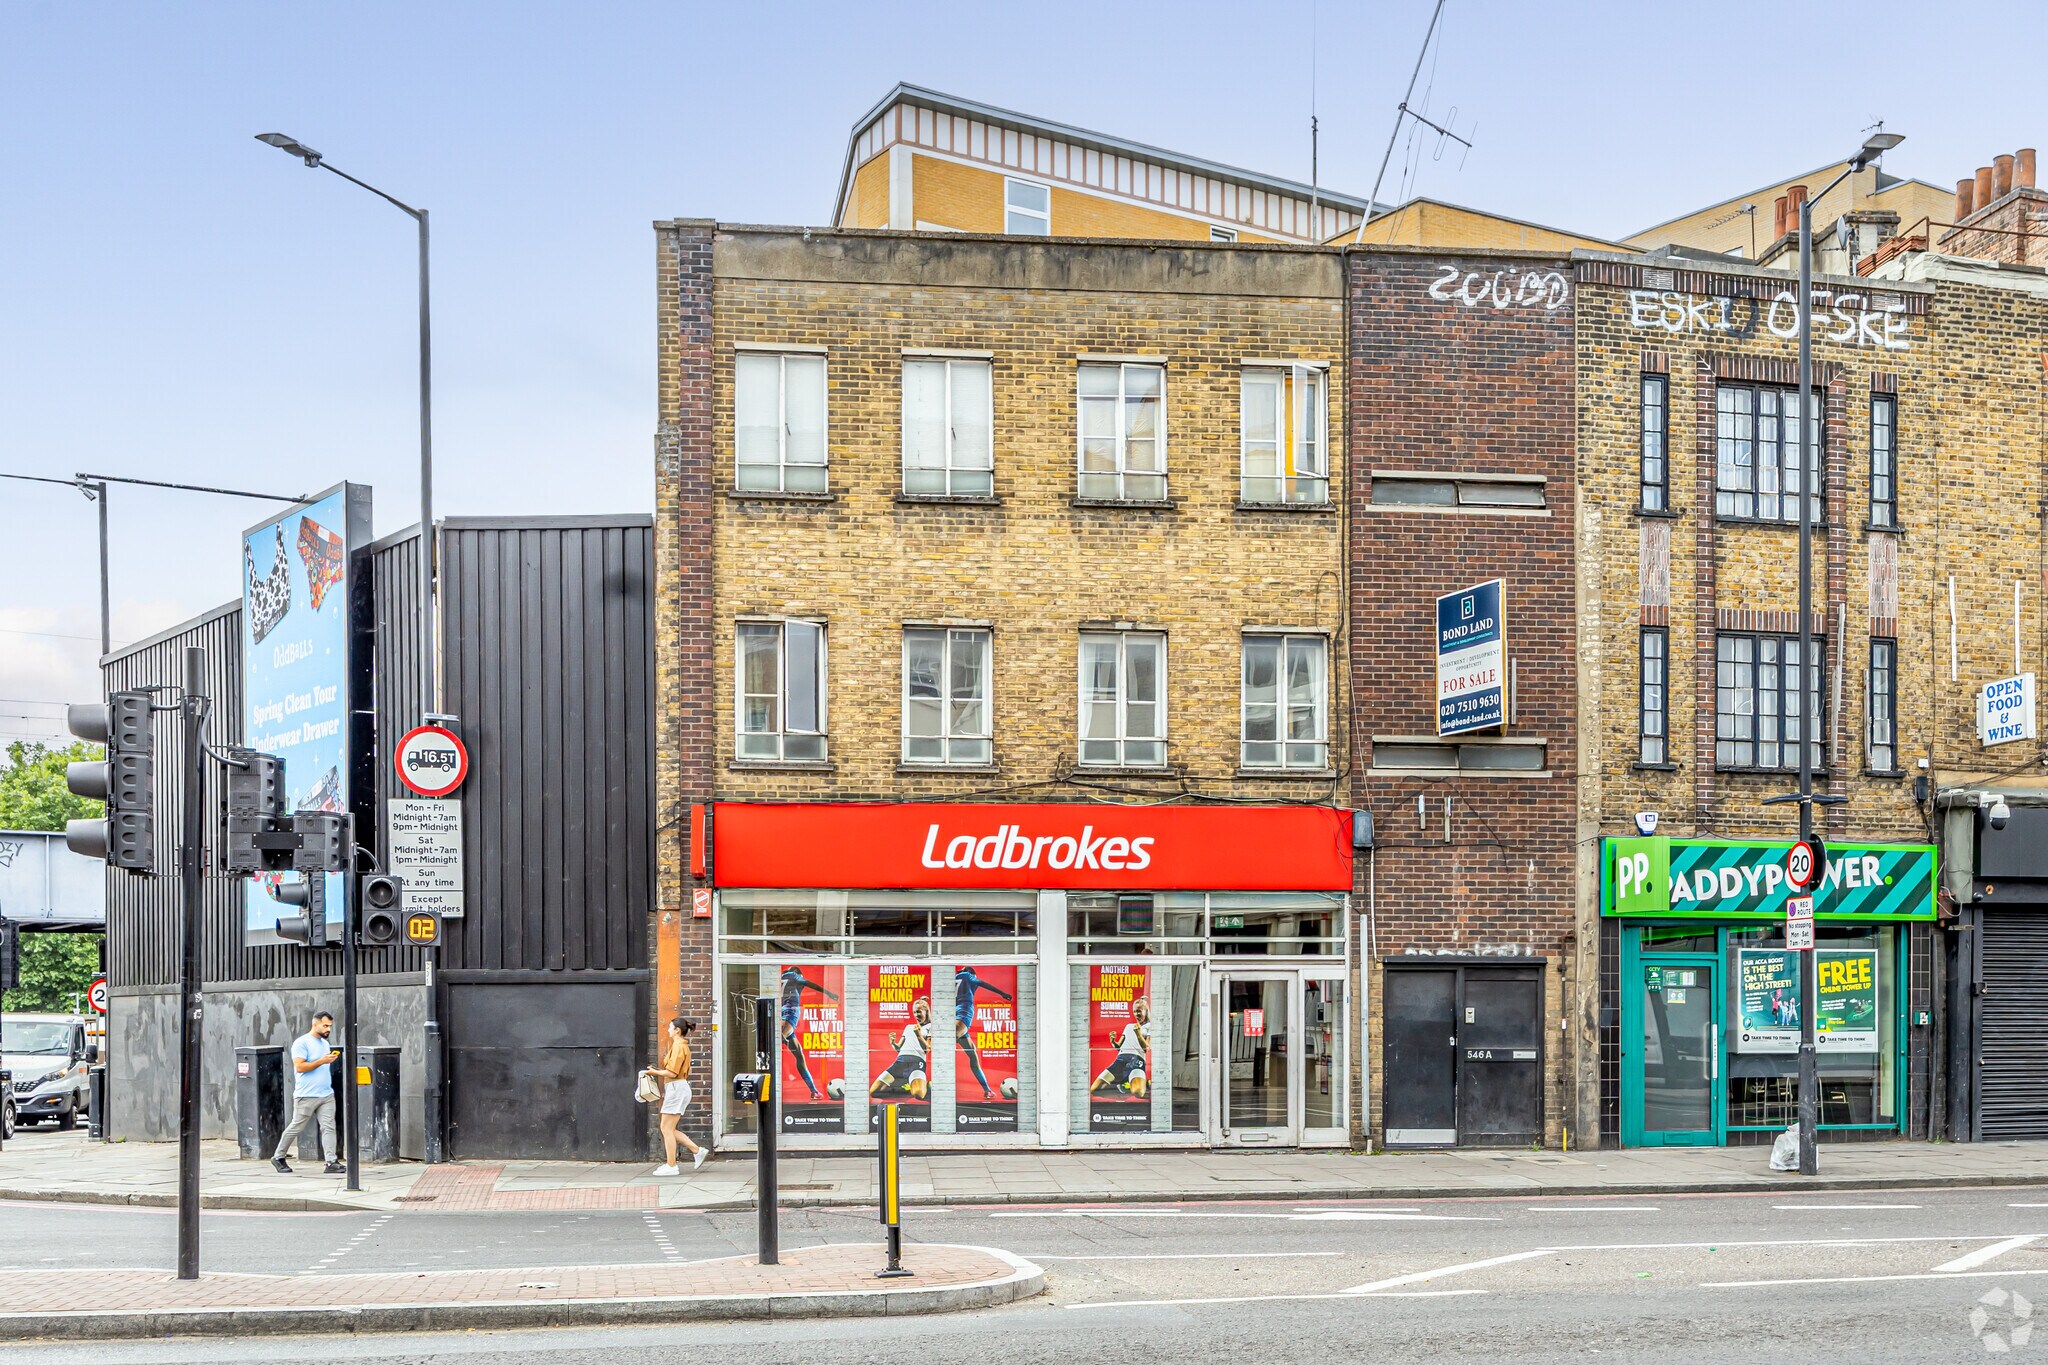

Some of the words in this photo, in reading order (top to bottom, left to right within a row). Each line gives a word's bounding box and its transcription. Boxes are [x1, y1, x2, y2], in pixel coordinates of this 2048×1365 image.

[1443, 625, 1468, 641] BOND
[1470, 617, 1493, 634] LAND
[1469, 649, 1500, 662] DEVELOPMENT
[1443, 676, 1466, 693] FOR
[1469, 668, 1496, 688] SALE
[1986, 679, 2023, 699] OPEN
[253, 699, 284, 728] Spring
[284, 692, 312, 715] Clean
[313, 685, 337, 707] Your
[1441, 703, 1455, 717] 020
[1457, 696, 1478, 713] 7510
[1479, 693, 1500, 709] 9630
[1987, 695, 2022, 713] FOOD
[1440, 709, 1501, 730] info@bond-land.co.uk
[2000, 712, 2009, 724] &
[252, 728, 301, 753] Underwear
[303, 718, 340, 742] Drawer
[1988, 723, 2023, 741] WINE
[423, 751, 455, 762] 16.5T
[393, 813, 432, 822] Midnight
[393, 823, 413, 832] 9pm
[420, 823, 458, 832] Midnight
[418, 836, 434, 844] Sat
[394, 846, 433, 854] Midnight
[440, 846, 457, 854] 7am
[921, 824, 1154, 870] Ladbrokes
[395, 856, 412, 864] 1pm
[419, 856, 458, 864] Midnight
[1791, 855, 1810, 872] 20
[1669, 855, 1893, 904] ADDYPWER.
[411, 895, 443, 904] Except
[1797, 908, 1812, 916] ROUTE
[409, 918, 435, 938] 02
[1795, 922, 1812, 930] stopping
[1800, 939, 1810, 947] 7pm
[880, 966, 909, 974] ANOTHER
[1101, 966, 1129, 974] ANOTHER
[1744, 966, 1751, 974] IS
[1752, 965, 1767, 973] THE
[1768, 963, 1784, 972] BEST
[1818, 958, 1872, 986] FREE
[880, 974, 925, 988] HISTORY
[1101, 974, 1145, 988] HISTORY
[1744, 974, 1757, 983] ON
[1759, 973, 1773, 981] THE
[1745, 981, 1764, 991] HIGH
[1765, 979, 1792, 989] STREET!
[1820, 986, 1841, 994] ONLINE
[1842, 984, 1862, 993] POWER
[870, 988, 913, 1002] MAKING
[1091, 988, 1133, 1002] MAKING
[880, 1002, 908, 1011] SUMMER
[1100, 1002, 1128, 1010] SUMMER
[803, 1009, 819, 1020] ALL
[820, 1009, 837, 1020] THE
[976, 1008, 992, 1020] ALL
[994, 1008, 1010, 1020] THE
[810, 1021, 831, 1032] WAY
[832, 1021, 843, 1032] TO
[983, 1020, 1002, 1032] WAY
[1005, 1020, 1016, 1032] TO
[803, 1033, 842, 1049] BASEL
[977, 1032, 1016, 1049] BASEL
